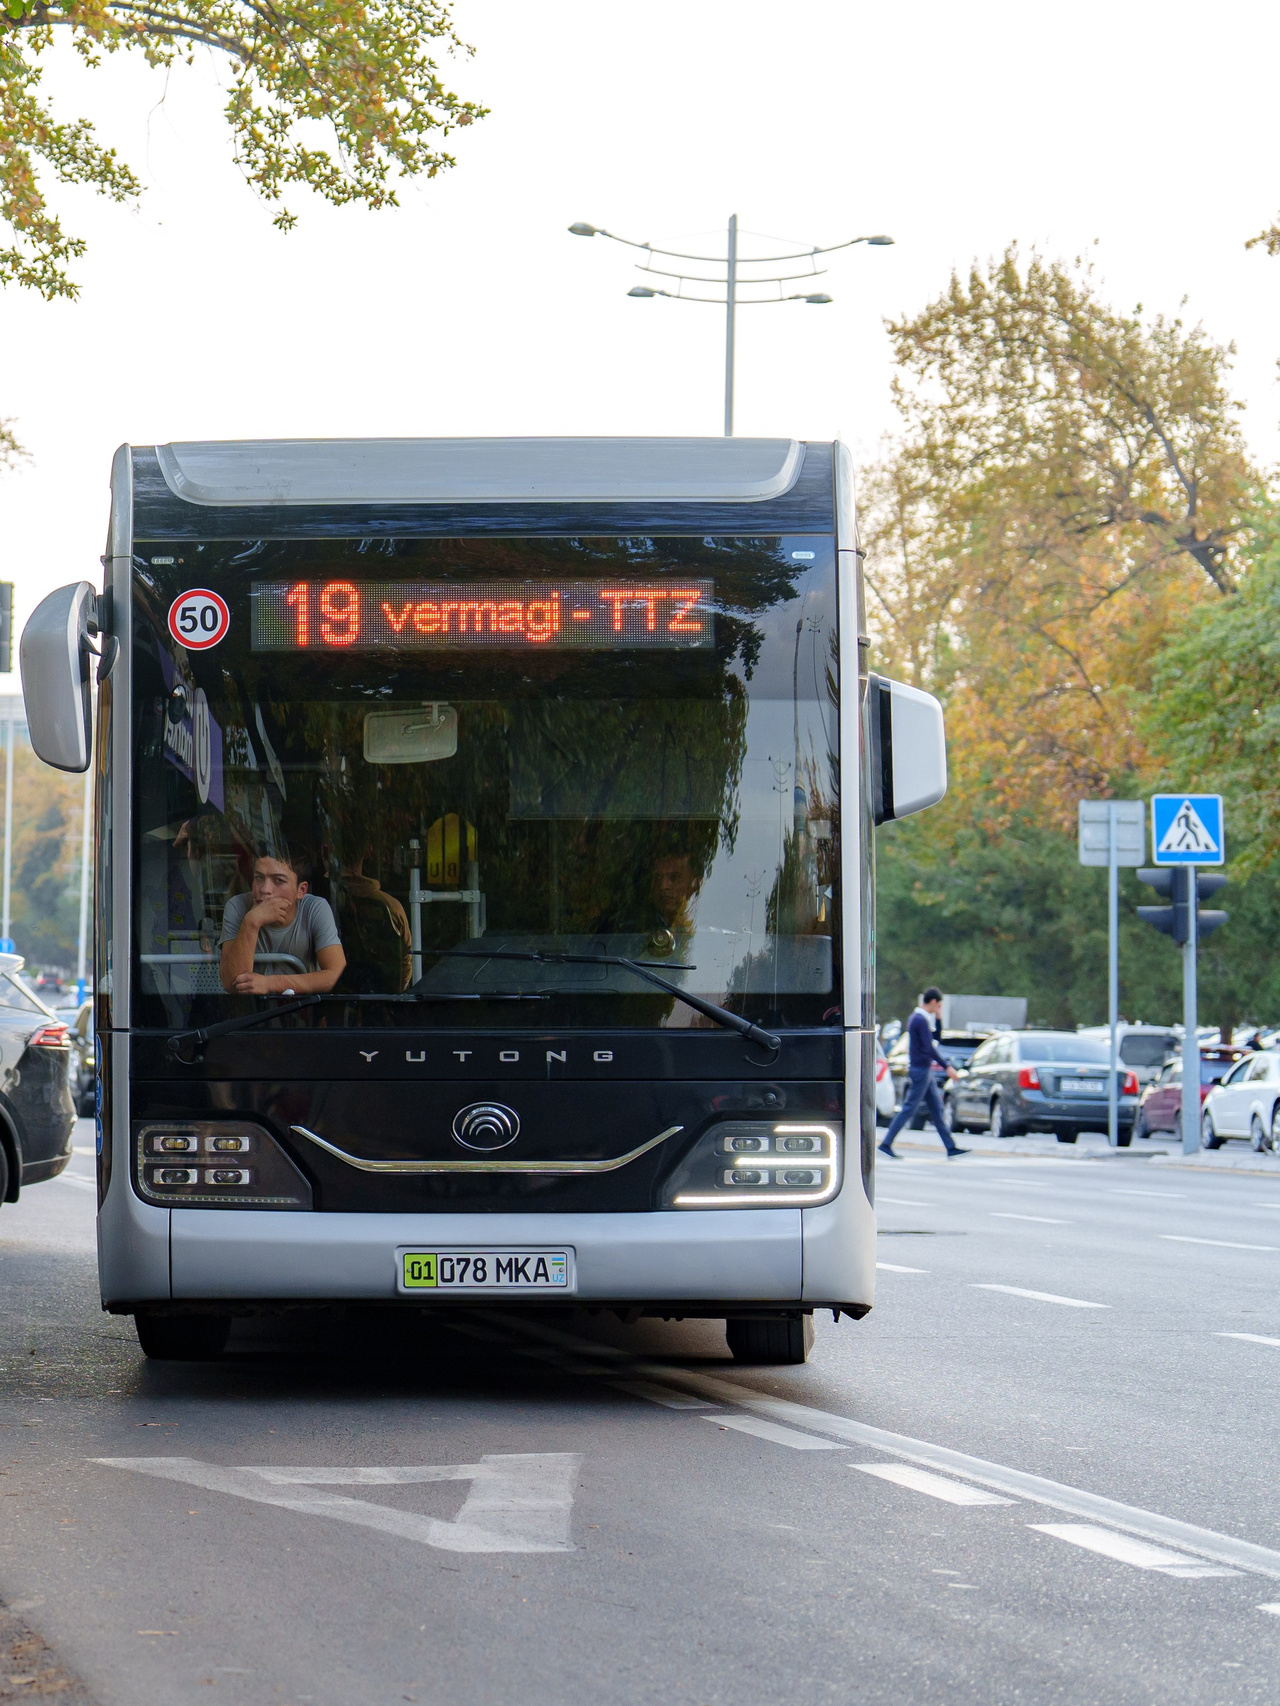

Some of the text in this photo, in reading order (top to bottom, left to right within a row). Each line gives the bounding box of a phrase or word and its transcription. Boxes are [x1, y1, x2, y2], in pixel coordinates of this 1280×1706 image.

[179, 605, 219, 633] 50
[287, 582, 361, 647] 19
[381, 591, 560, 641] vermagi
[600, 590, 702, 631] TTZ
[359, 1050, 614, 1062] YUTONG
[410, 1257, 550, 1283] 01 078 MKA
[552, 1273, 565, 1283] UZ
